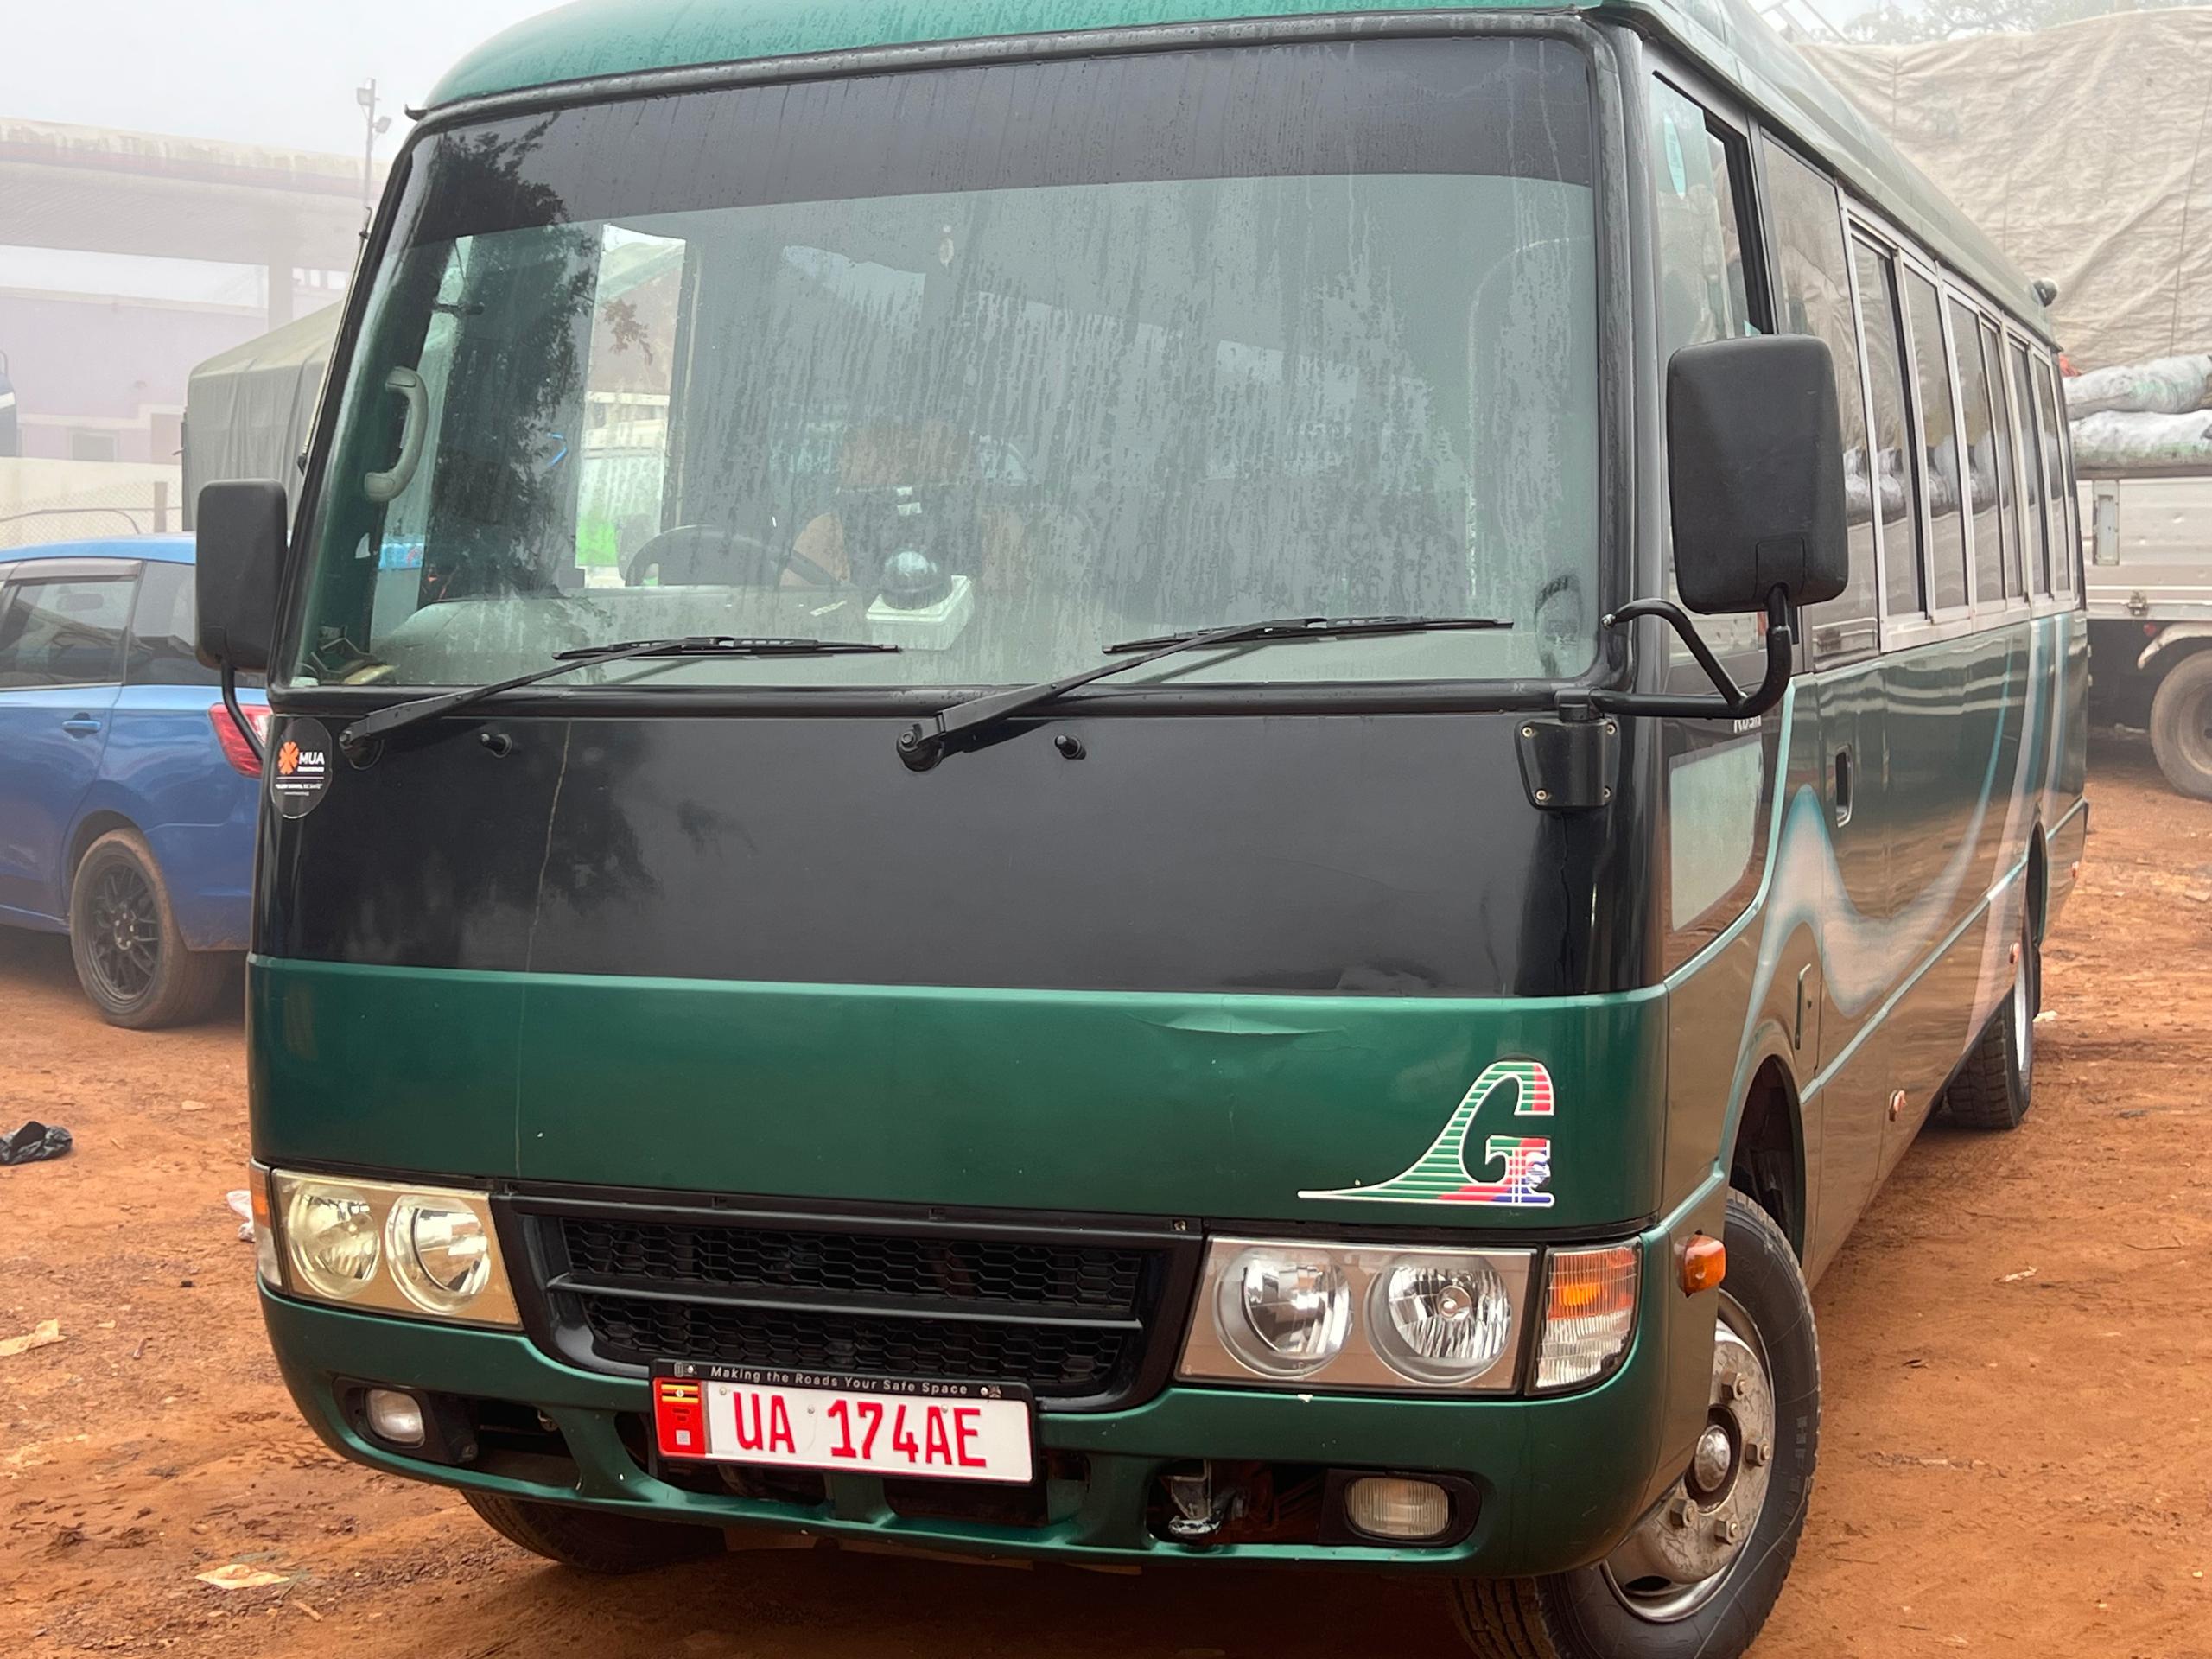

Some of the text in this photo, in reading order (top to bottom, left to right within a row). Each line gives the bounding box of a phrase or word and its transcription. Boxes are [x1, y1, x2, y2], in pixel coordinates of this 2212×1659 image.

[298, 751, 325, 765] MUA
[711, 1365, 760, 1382] Making
[767, 1370, 789, 1382] the
[795, 1372, 837, 1387] Roads
[844, 1377, 877, 1390] Your
[883, 1379, 916, 1392] Safe
[922, 1382, 968, 1395] Space
[733, 1391, 987, 1468] UA 174AE
